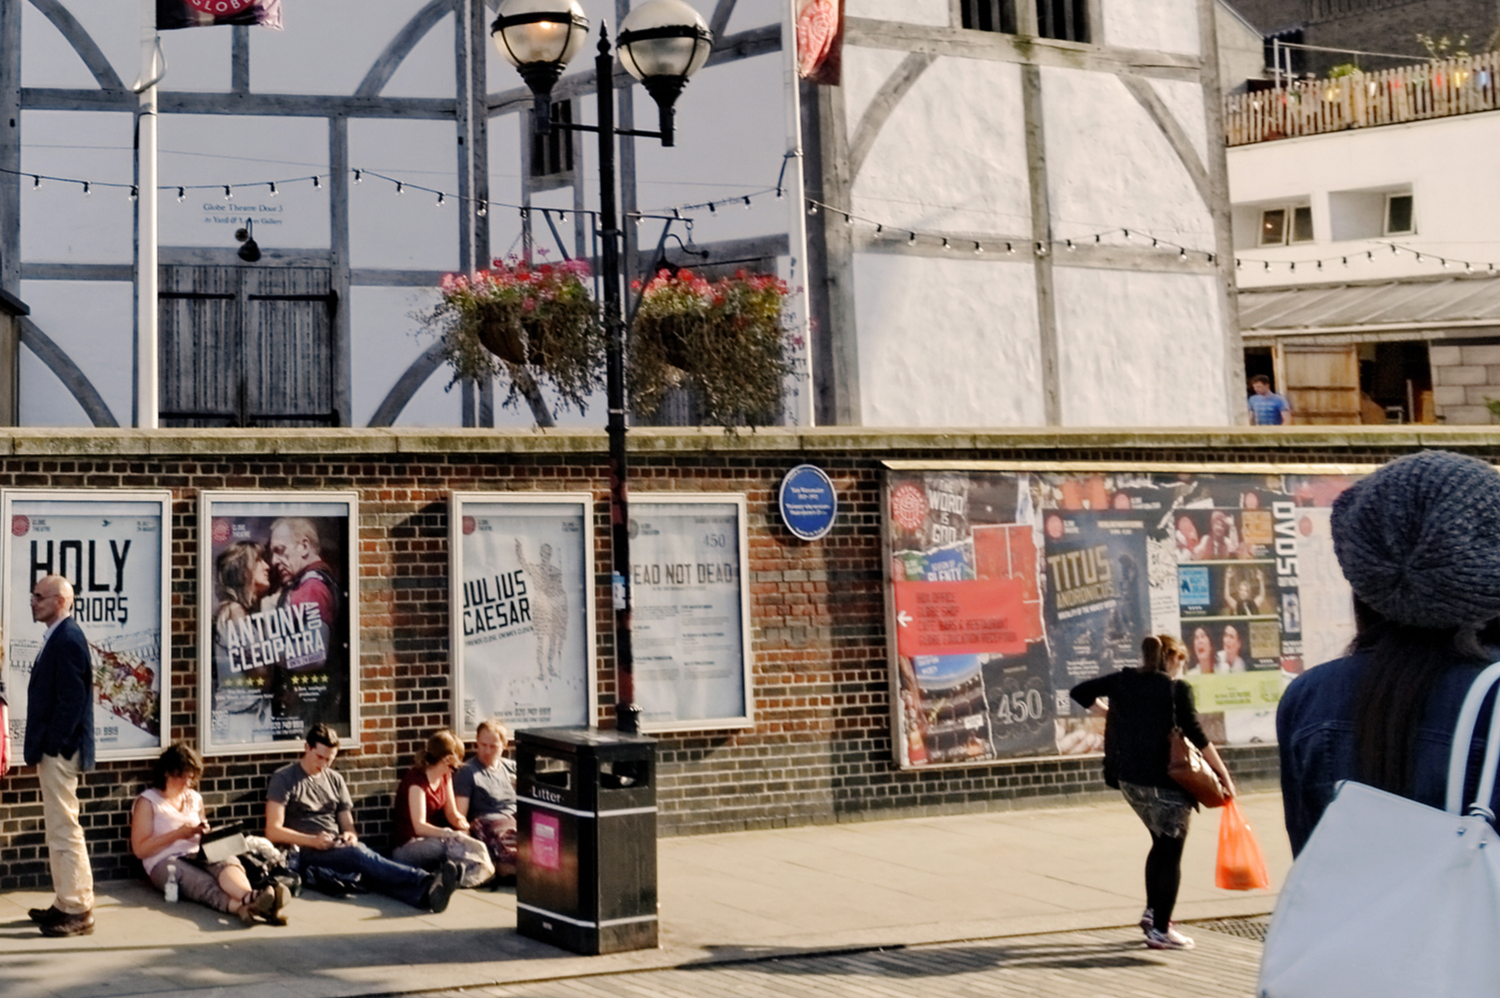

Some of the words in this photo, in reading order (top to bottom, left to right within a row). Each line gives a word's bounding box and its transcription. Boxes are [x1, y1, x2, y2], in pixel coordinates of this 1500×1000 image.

[203, 203, 226, 211] Globe
[229, 204, 257, 212] Theatre
[259, 204, 277, 212] Door
[928, 489, 964, 515] WORD
[704, 533, 726, 548] 450
[932, 523, 957, 546] GOD
[1272, 501, 1300, 575] DVDS
[30, 540, 131, 594] HOLY
[630, 564, 660, 585] EAD
[665, 564, 692, 585] NOT
[697, 563, 733, 584] DEAD
[927, 568, 962, 581] PLENTY
[1046, 544, 1112, 592] TITUS
[463, 570, 527, 609] JULIUS
[1056, 581, 1115, 610] ANDRONICUS
[227, 602, 306, 650] ANTONY
[304, 602, 322, 629] AND
[463, 597, 531, 636] CAESAR
[228, 629, 326, 673] CLEOPATRA
[997, 688, 1043, 725] 450
[531, 785, 561, 803] Litter
